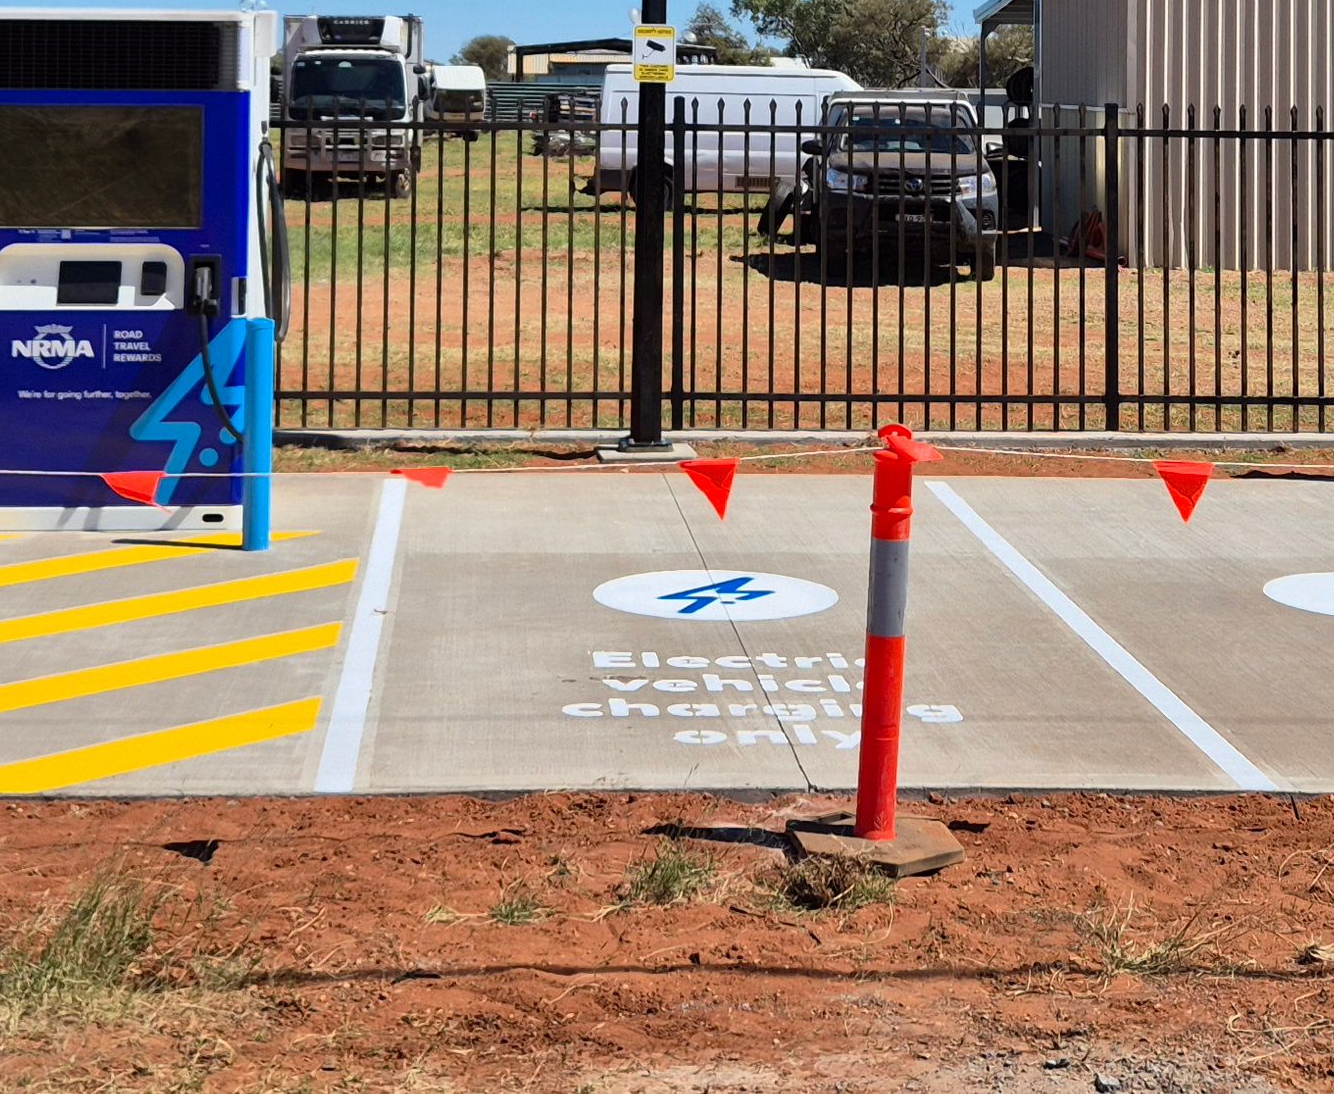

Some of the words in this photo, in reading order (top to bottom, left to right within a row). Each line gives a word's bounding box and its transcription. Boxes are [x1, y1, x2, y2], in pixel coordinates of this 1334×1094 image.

[113, 330, 143, 339] ROAD
[11, 340, 95, 357] NRMA
[113, 342, 151, 351] TRAVEL
[113, 353, 162, 362] REWARDS
[18, 390, 42, 398] We're
[43, 390, 55, 398] for
[57, 391, 82, 400] going
[590, 650, 865, 669] Electri
[602, 674, 863, 692] vehicl
